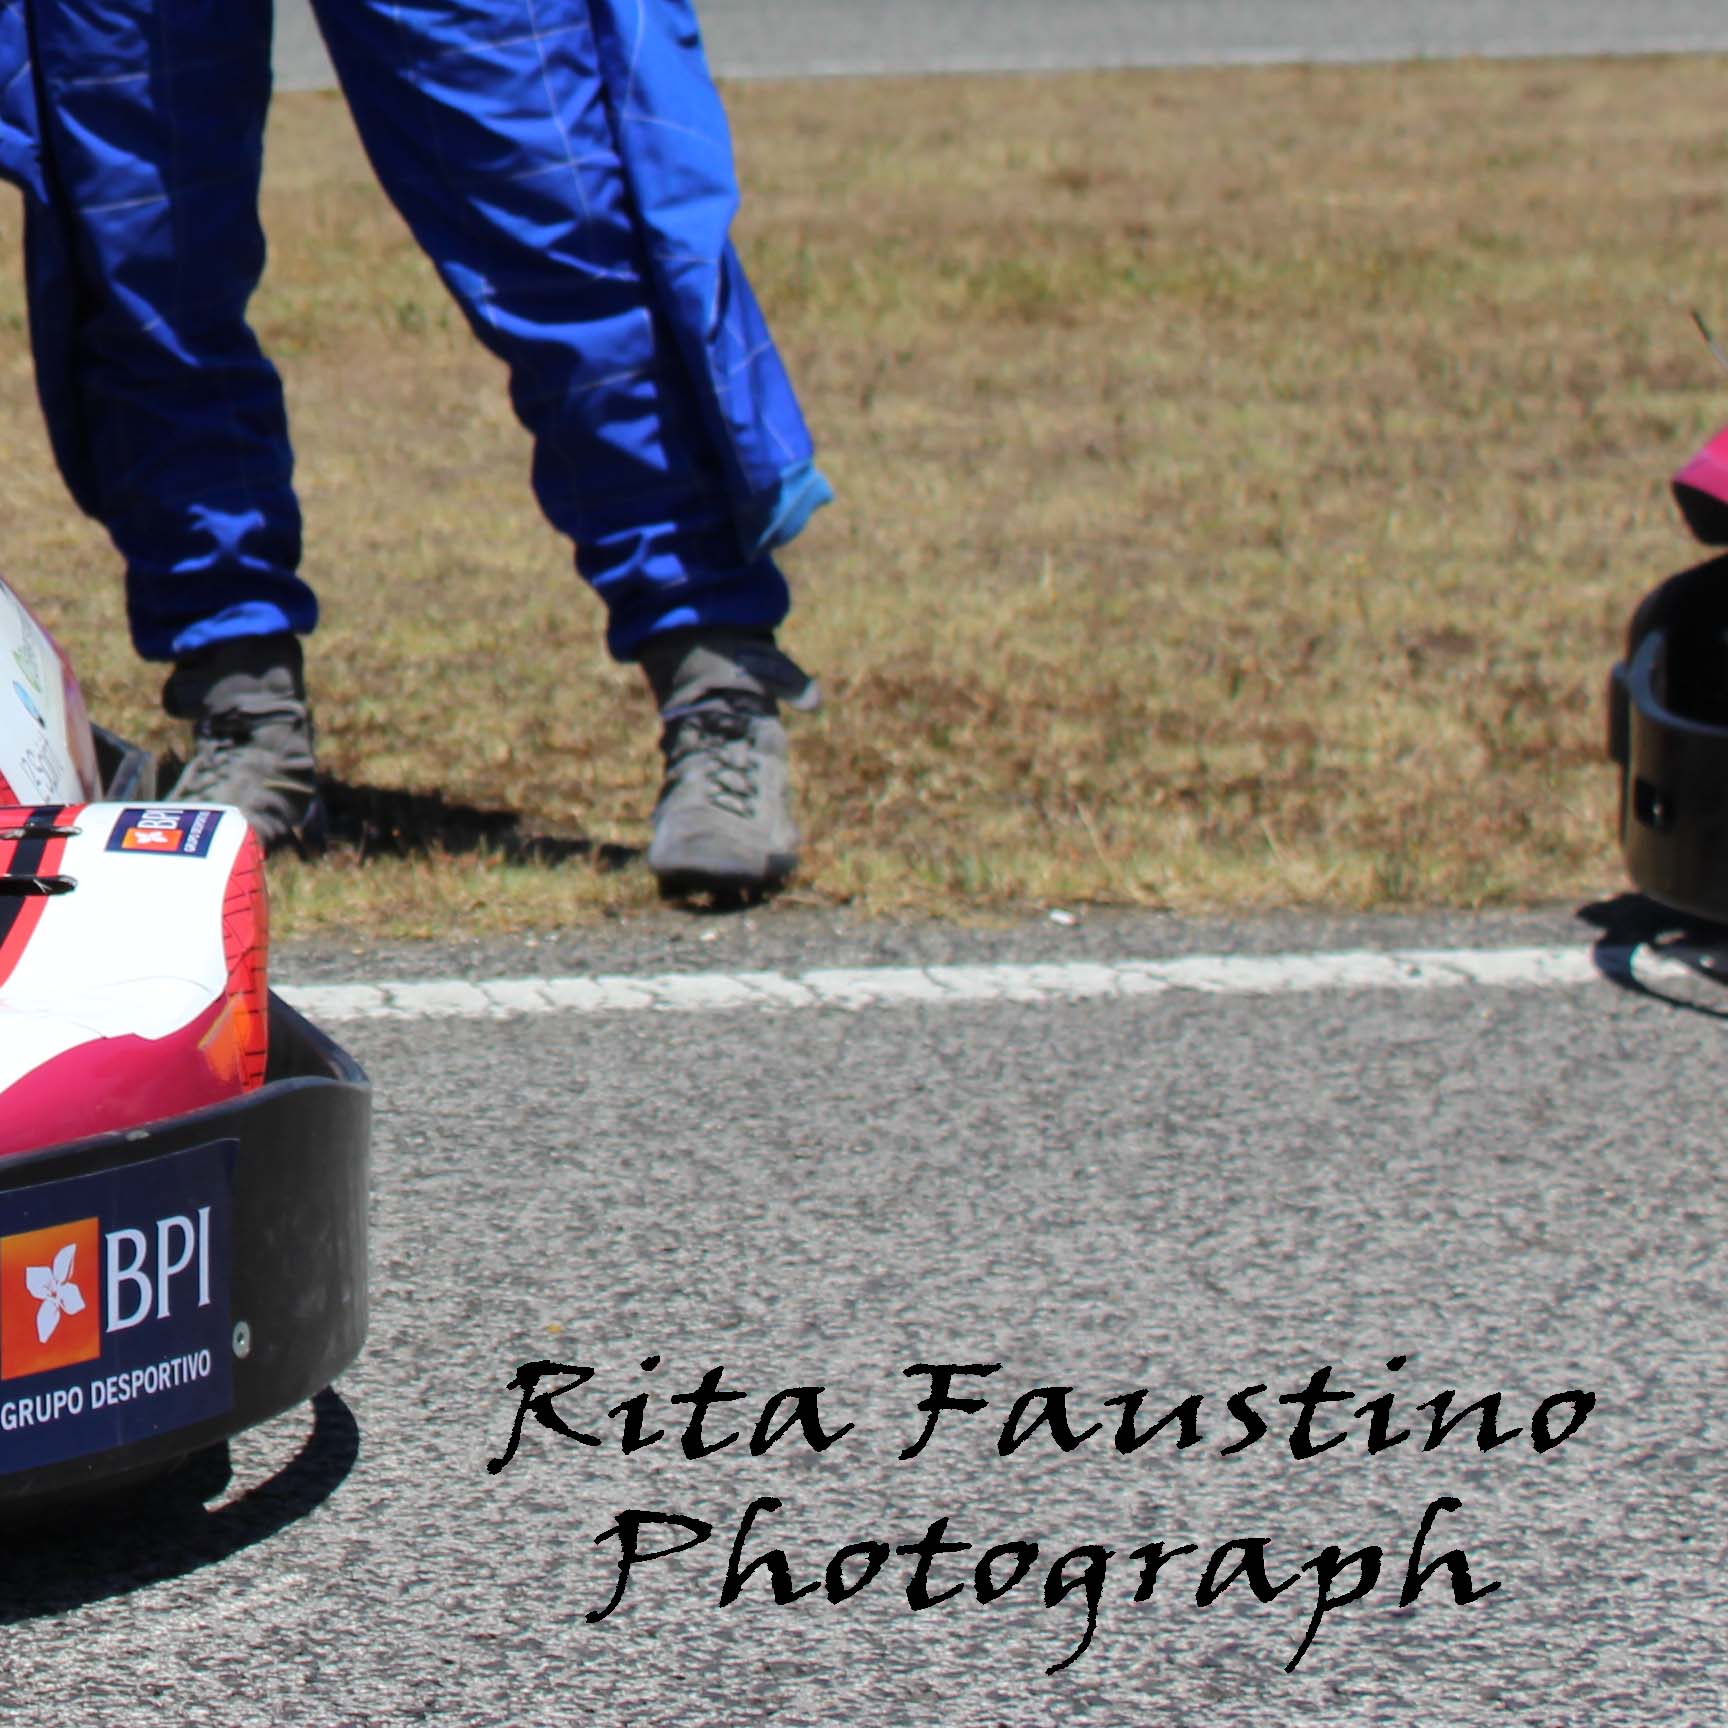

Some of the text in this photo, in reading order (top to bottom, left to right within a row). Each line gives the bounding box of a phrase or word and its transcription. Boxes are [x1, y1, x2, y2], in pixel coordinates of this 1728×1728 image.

[137, 810, 184, 829] BPI
[105, 1207, 212, 1333] BPI
[1, 1349, 211, 1430] GRUPO DESPORTIVO
